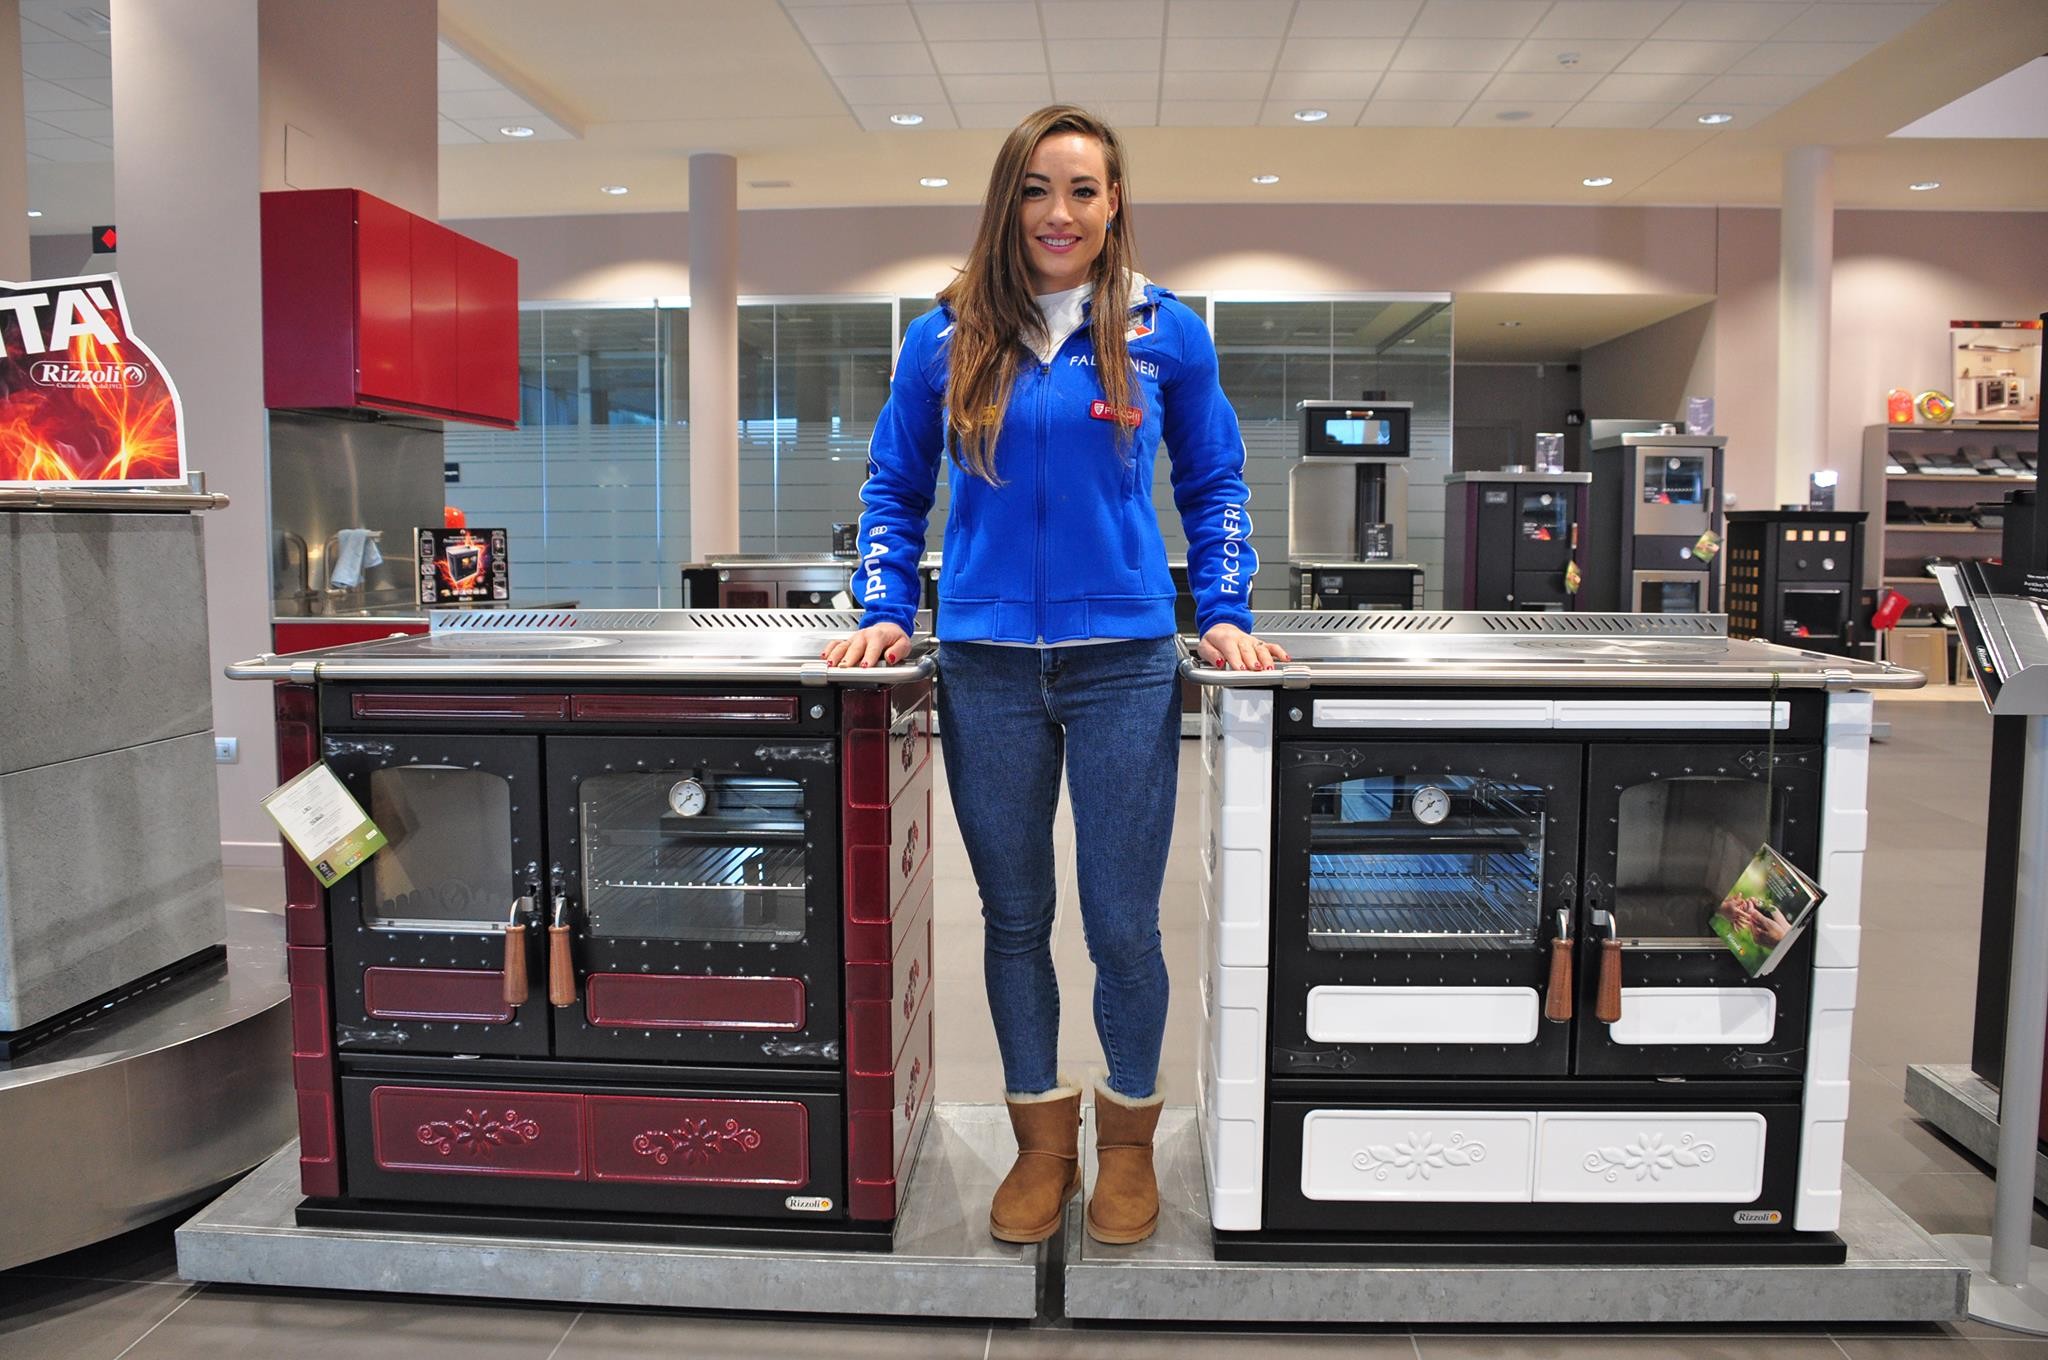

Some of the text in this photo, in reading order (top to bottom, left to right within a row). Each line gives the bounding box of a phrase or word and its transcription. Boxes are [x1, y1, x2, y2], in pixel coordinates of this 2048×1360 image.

[40, 364, 121, 383] Rizzoli
[1069, 355, 1160, 380] FALNERI
[864, 542, 889, 602] Audi
[790, 1199, 820, 1208] Rizzoli
[1738, 1213, 1770, 1221] Rizzoli
